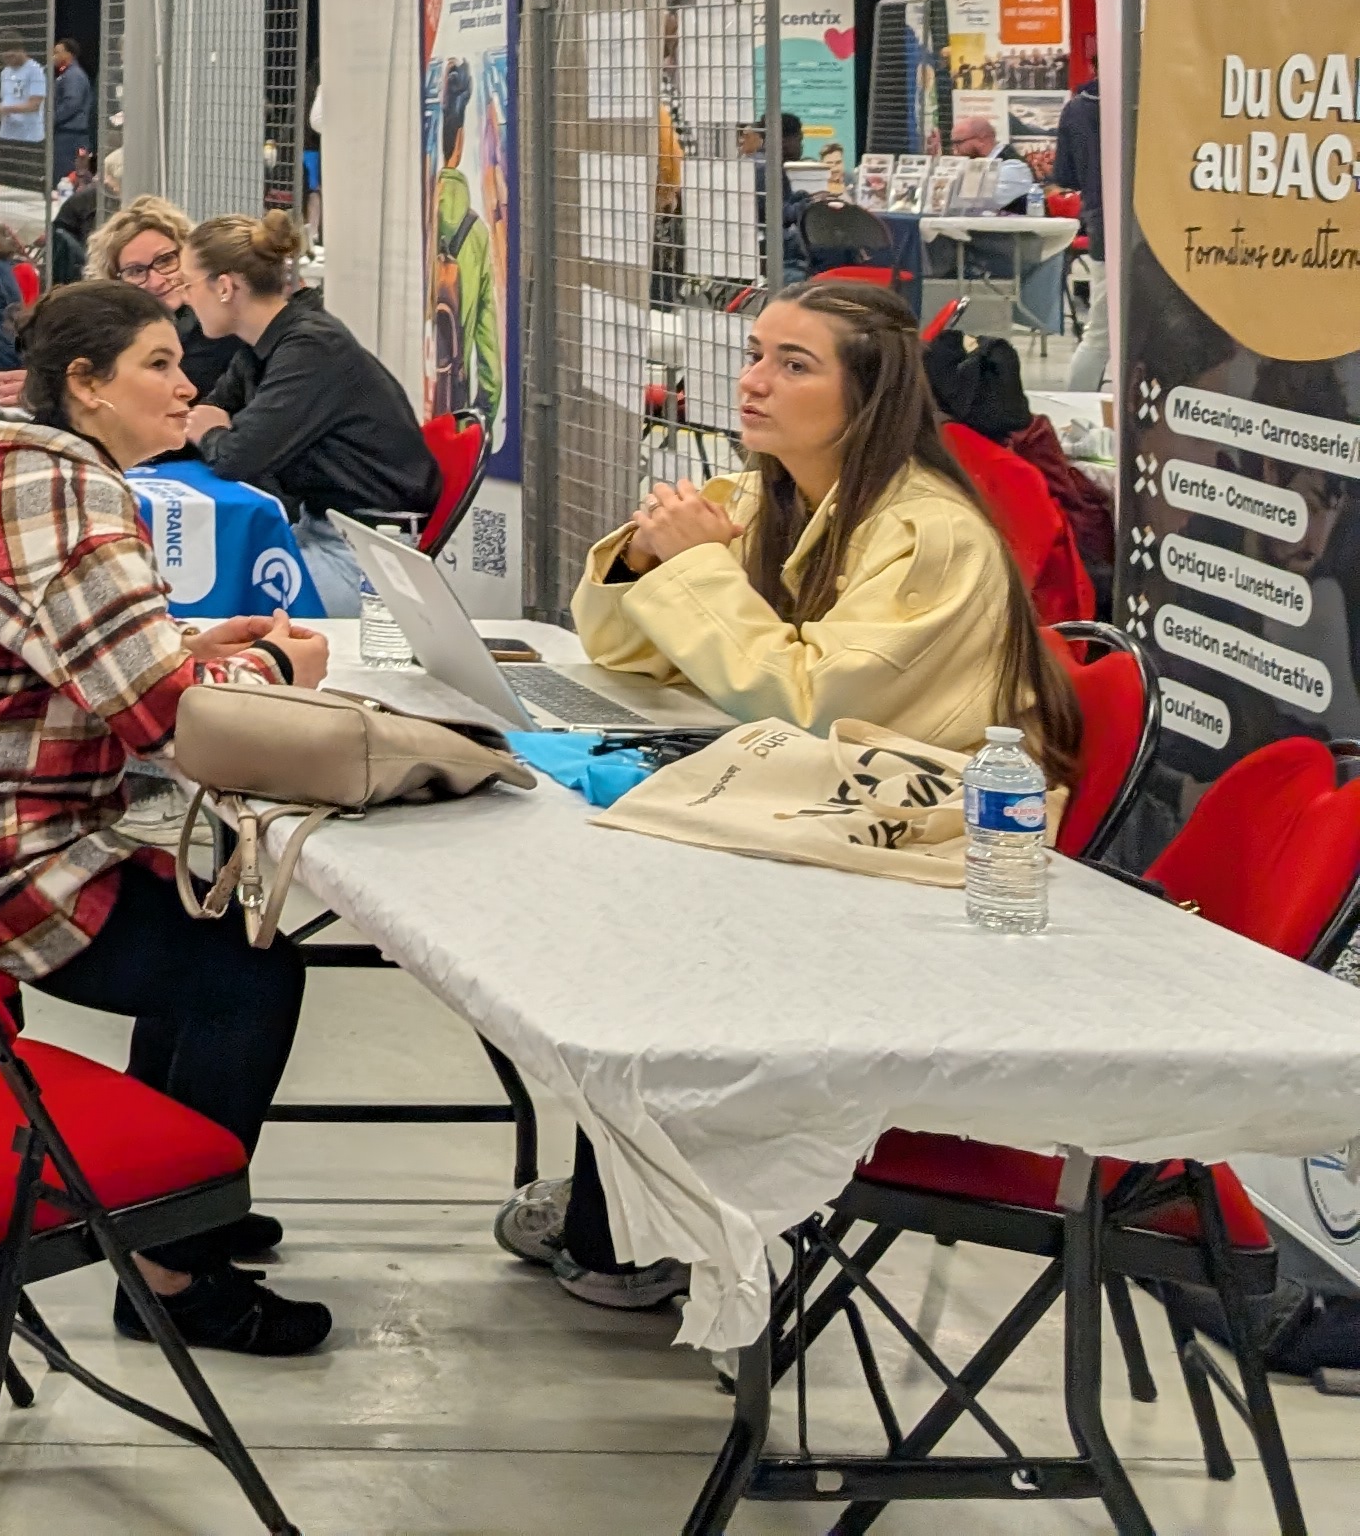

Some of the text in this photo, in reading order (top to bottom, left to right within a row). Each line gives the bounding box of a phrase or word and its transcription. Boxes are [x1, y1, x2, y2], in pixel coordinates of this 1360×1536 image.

[754, 10, 841, 26] cocentrix
[1222, 54, 1271, 119] Du
[1190, 141, 1243, 194] au
[1185, 218, 1360, 272] Formations en altern
[1173, 398, 1253, 438] Mécanique
[1261, 418, 1360, 464] Carrosserie/
[1168, 469, 1216, 502] Vente
[1225, 486, 1298, 527] Commerce
[1167, 546, 1226, 582] Optique
[1235, 567, 1305, 611] Lunetterie
[1163, 616, 1324, 697] Gestion administrative
[1162, 691, 1223, 734] ourisme
[753, 731, 801, 760] Laho
